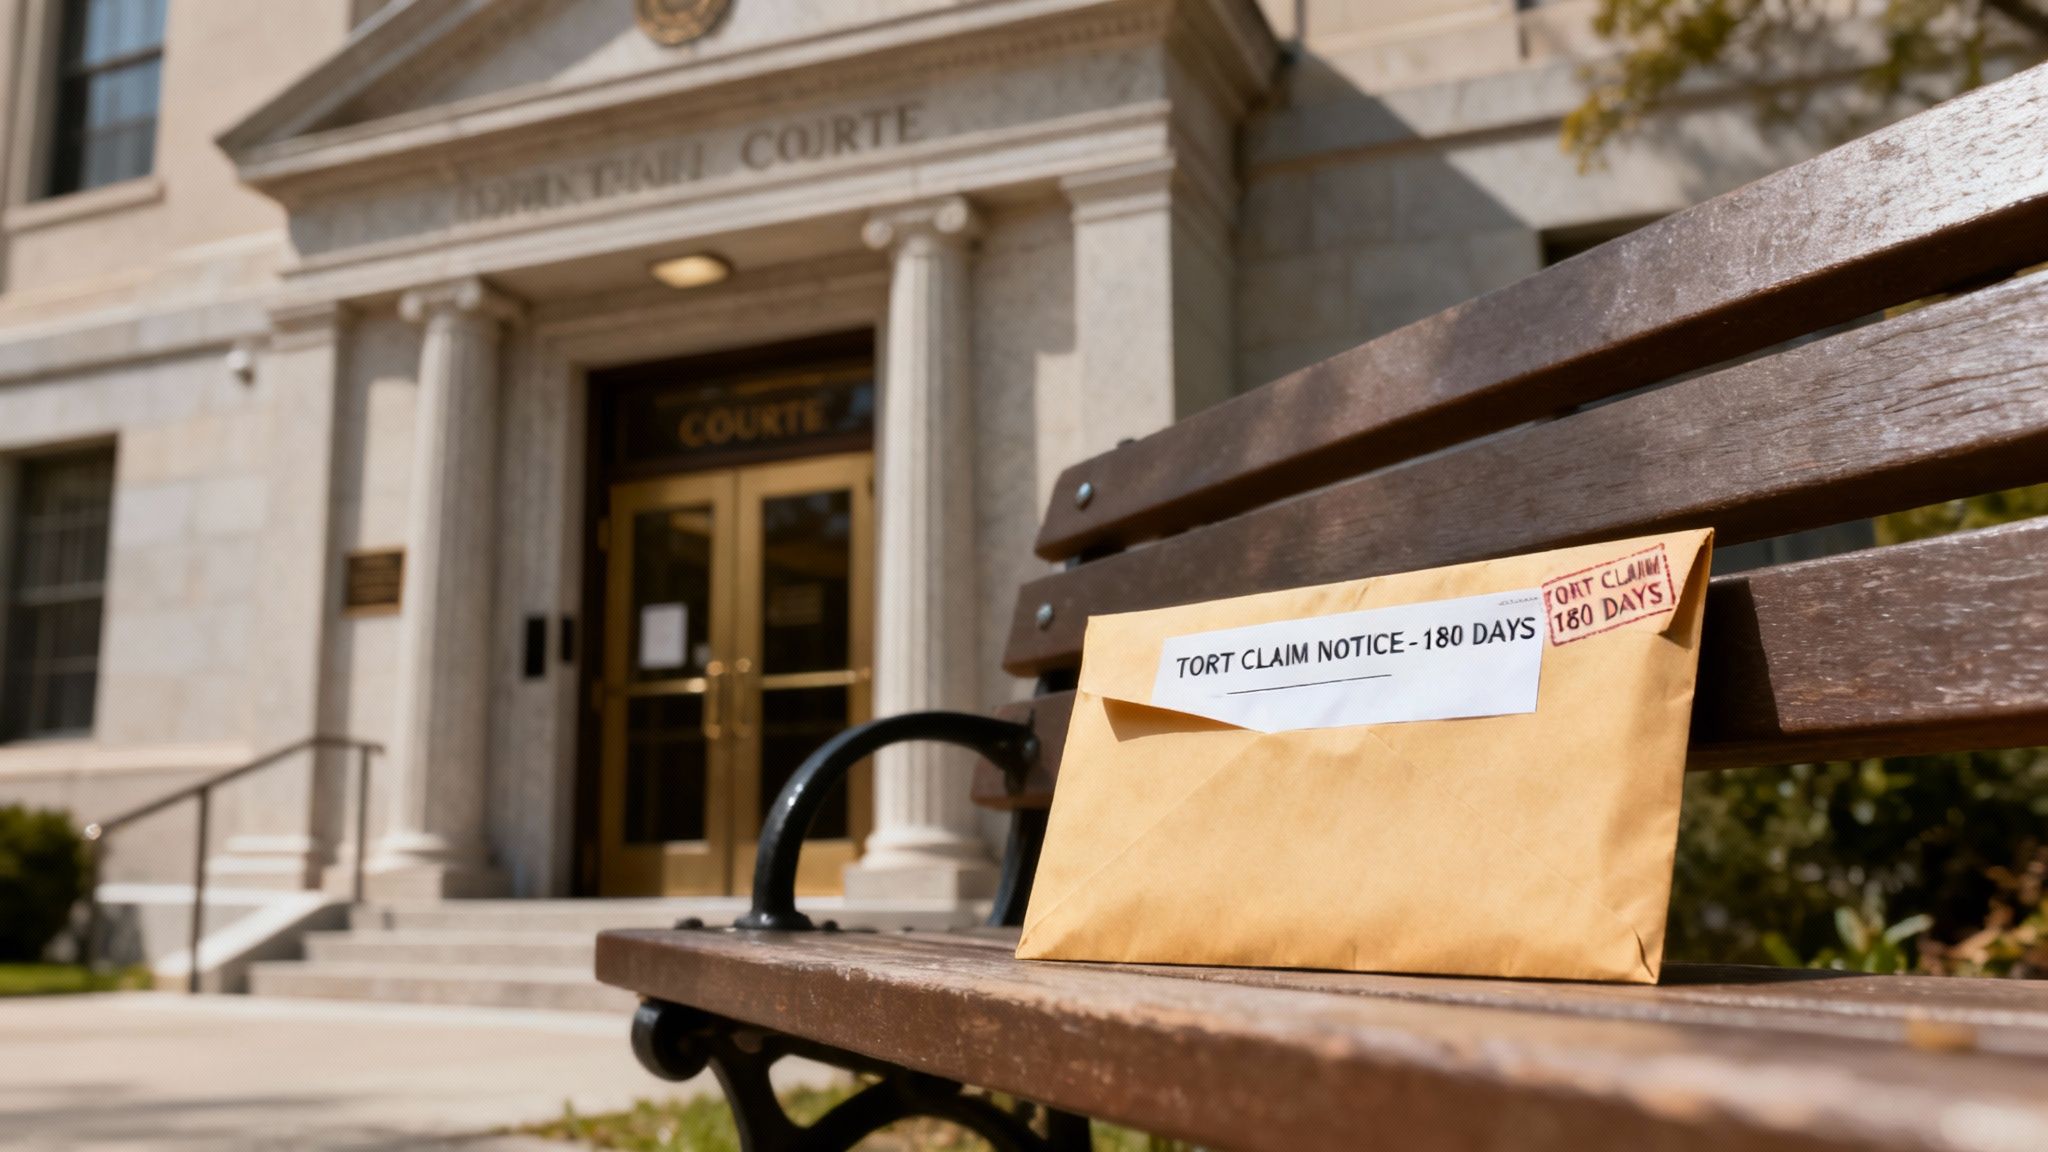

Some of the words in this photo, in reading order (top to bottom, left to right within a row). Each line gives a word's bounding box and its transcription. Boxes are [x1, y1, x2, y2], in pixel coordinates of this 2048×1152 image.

[1553, 602, 1594, 633] 180
[1602, 580, 1664, 622] DAYS
[1176, 652, 1235, 679] TORT
[1241, 642, 1310, 671] CLAIM
[1472, 616, 1537, 646] DAYS
